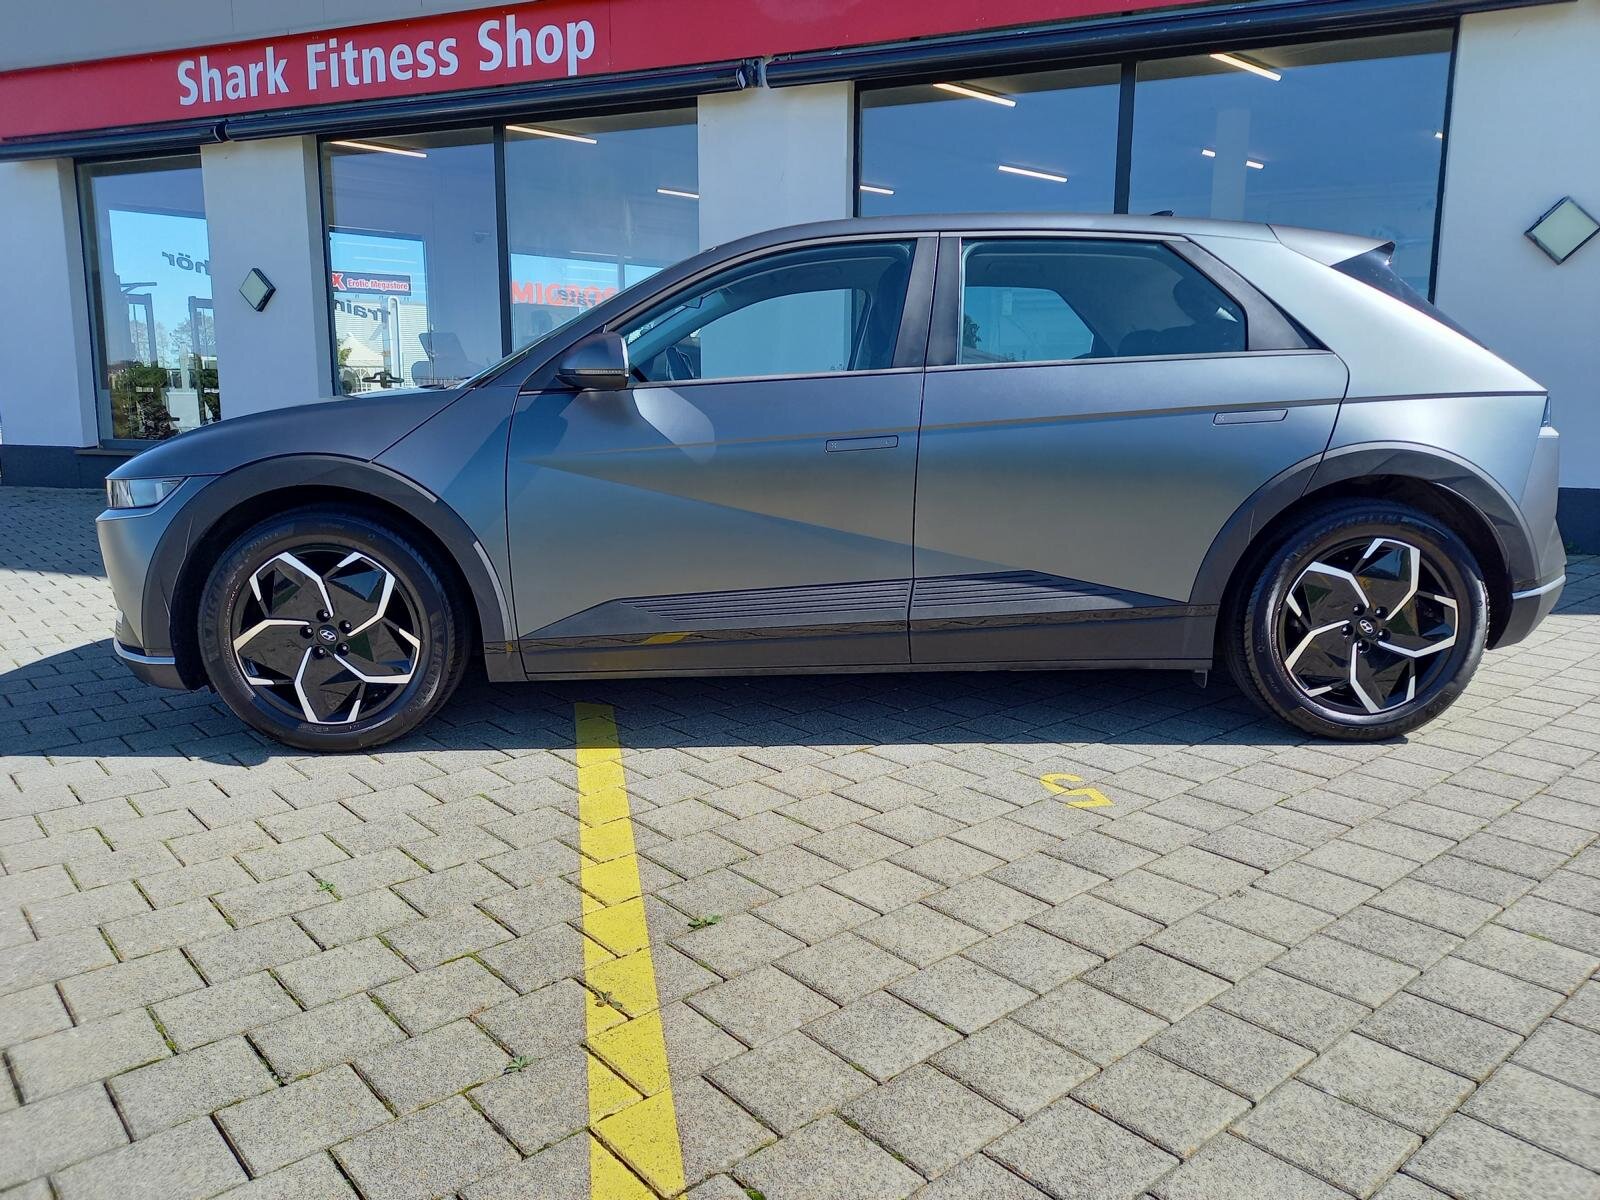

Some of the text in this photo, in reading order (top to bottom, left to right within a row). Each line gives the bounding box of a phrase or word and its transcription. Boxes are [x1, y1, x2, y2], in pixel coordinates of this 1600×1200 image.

[177, 14, 595, 106] Shark Fitness Shop
[347, 278, 369, 289] Erotic
[370, 280, 409, 291] Megastore
